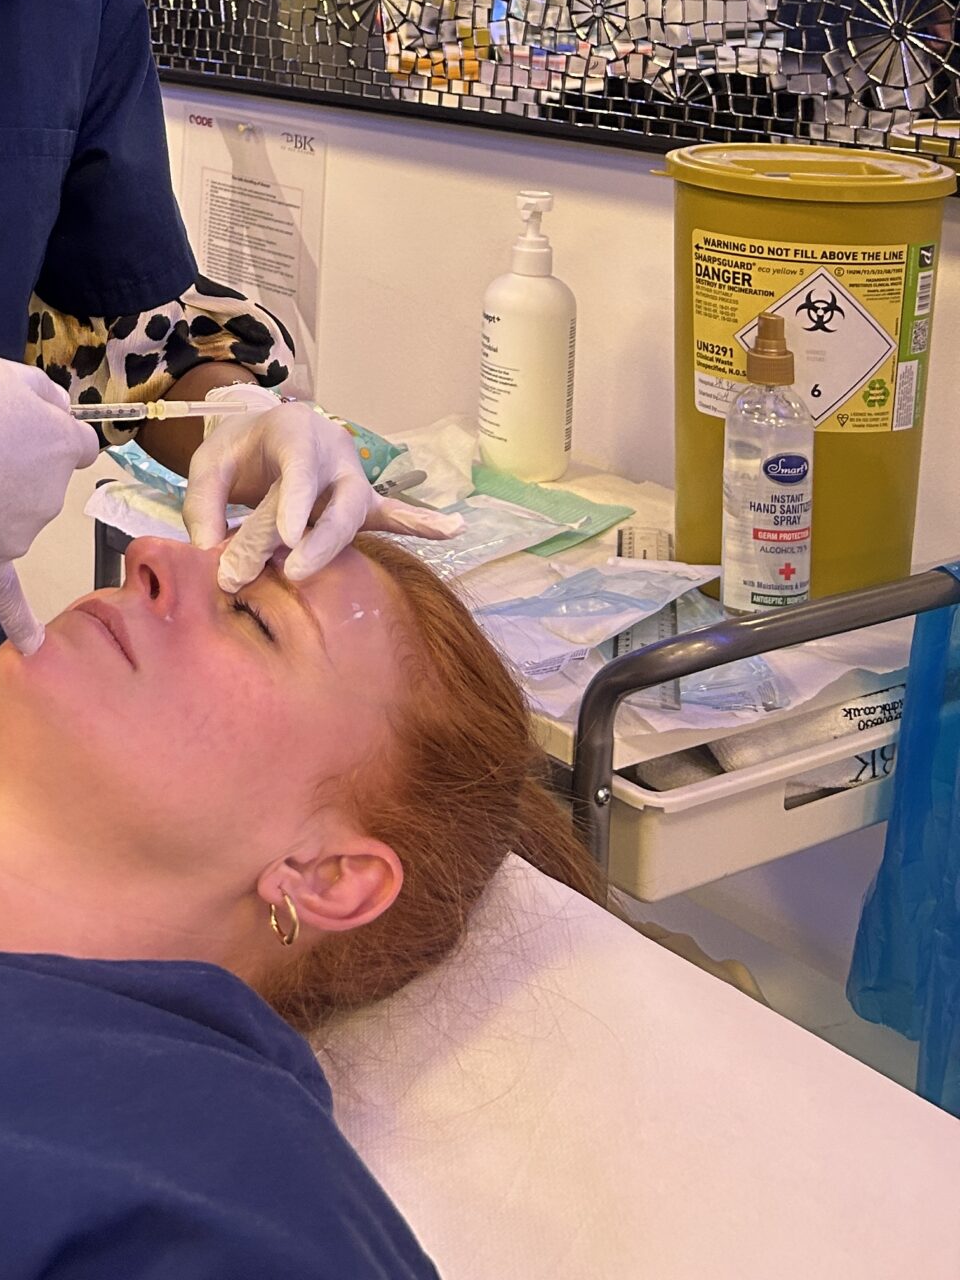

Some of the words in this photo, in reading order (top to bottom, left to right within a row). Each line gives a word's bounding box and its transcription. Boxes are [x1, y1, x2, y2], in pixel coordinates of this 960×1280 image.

[189, 114, 213, 128] CODE
[280, 132, 315, 152] DBK
[703, 236, 747, 252] WARNING
[749, 244, 765, 255] DO
[767, 246, 791, 257] NOT
[793, 249, 817, 259] FILL
[820, 250, 858, 261] ABOVE
[861, 251, 881, 261] THE
[883, 251, 904, 260] LINE
[695, 263, 753, 288] DANGER
[772, 267, 797, 276] yellow
[799, 267, 804, 276] 5
[695, 278, 717, 289] DESTROY
[727, 285, 775, 297] INCINERATION
[696, 340, 733, 358] UN3291
[696, 352, 714, 363] Clinical
[715, 357, 733, 367] Waste
[696, 360, 727, 374] Unspecified,
[810, 383, 822, 398] 6
[771, 493, 804, 504] INSTANT
[749, 501, 777, 515] HAND
[773, 515, 801, 526] SPRAY
[758, 531, 778, 540] GERM
[759, 546, 796, 554] ALCOHOL
[752, 595, 783, 605] ANTISEPTIC
